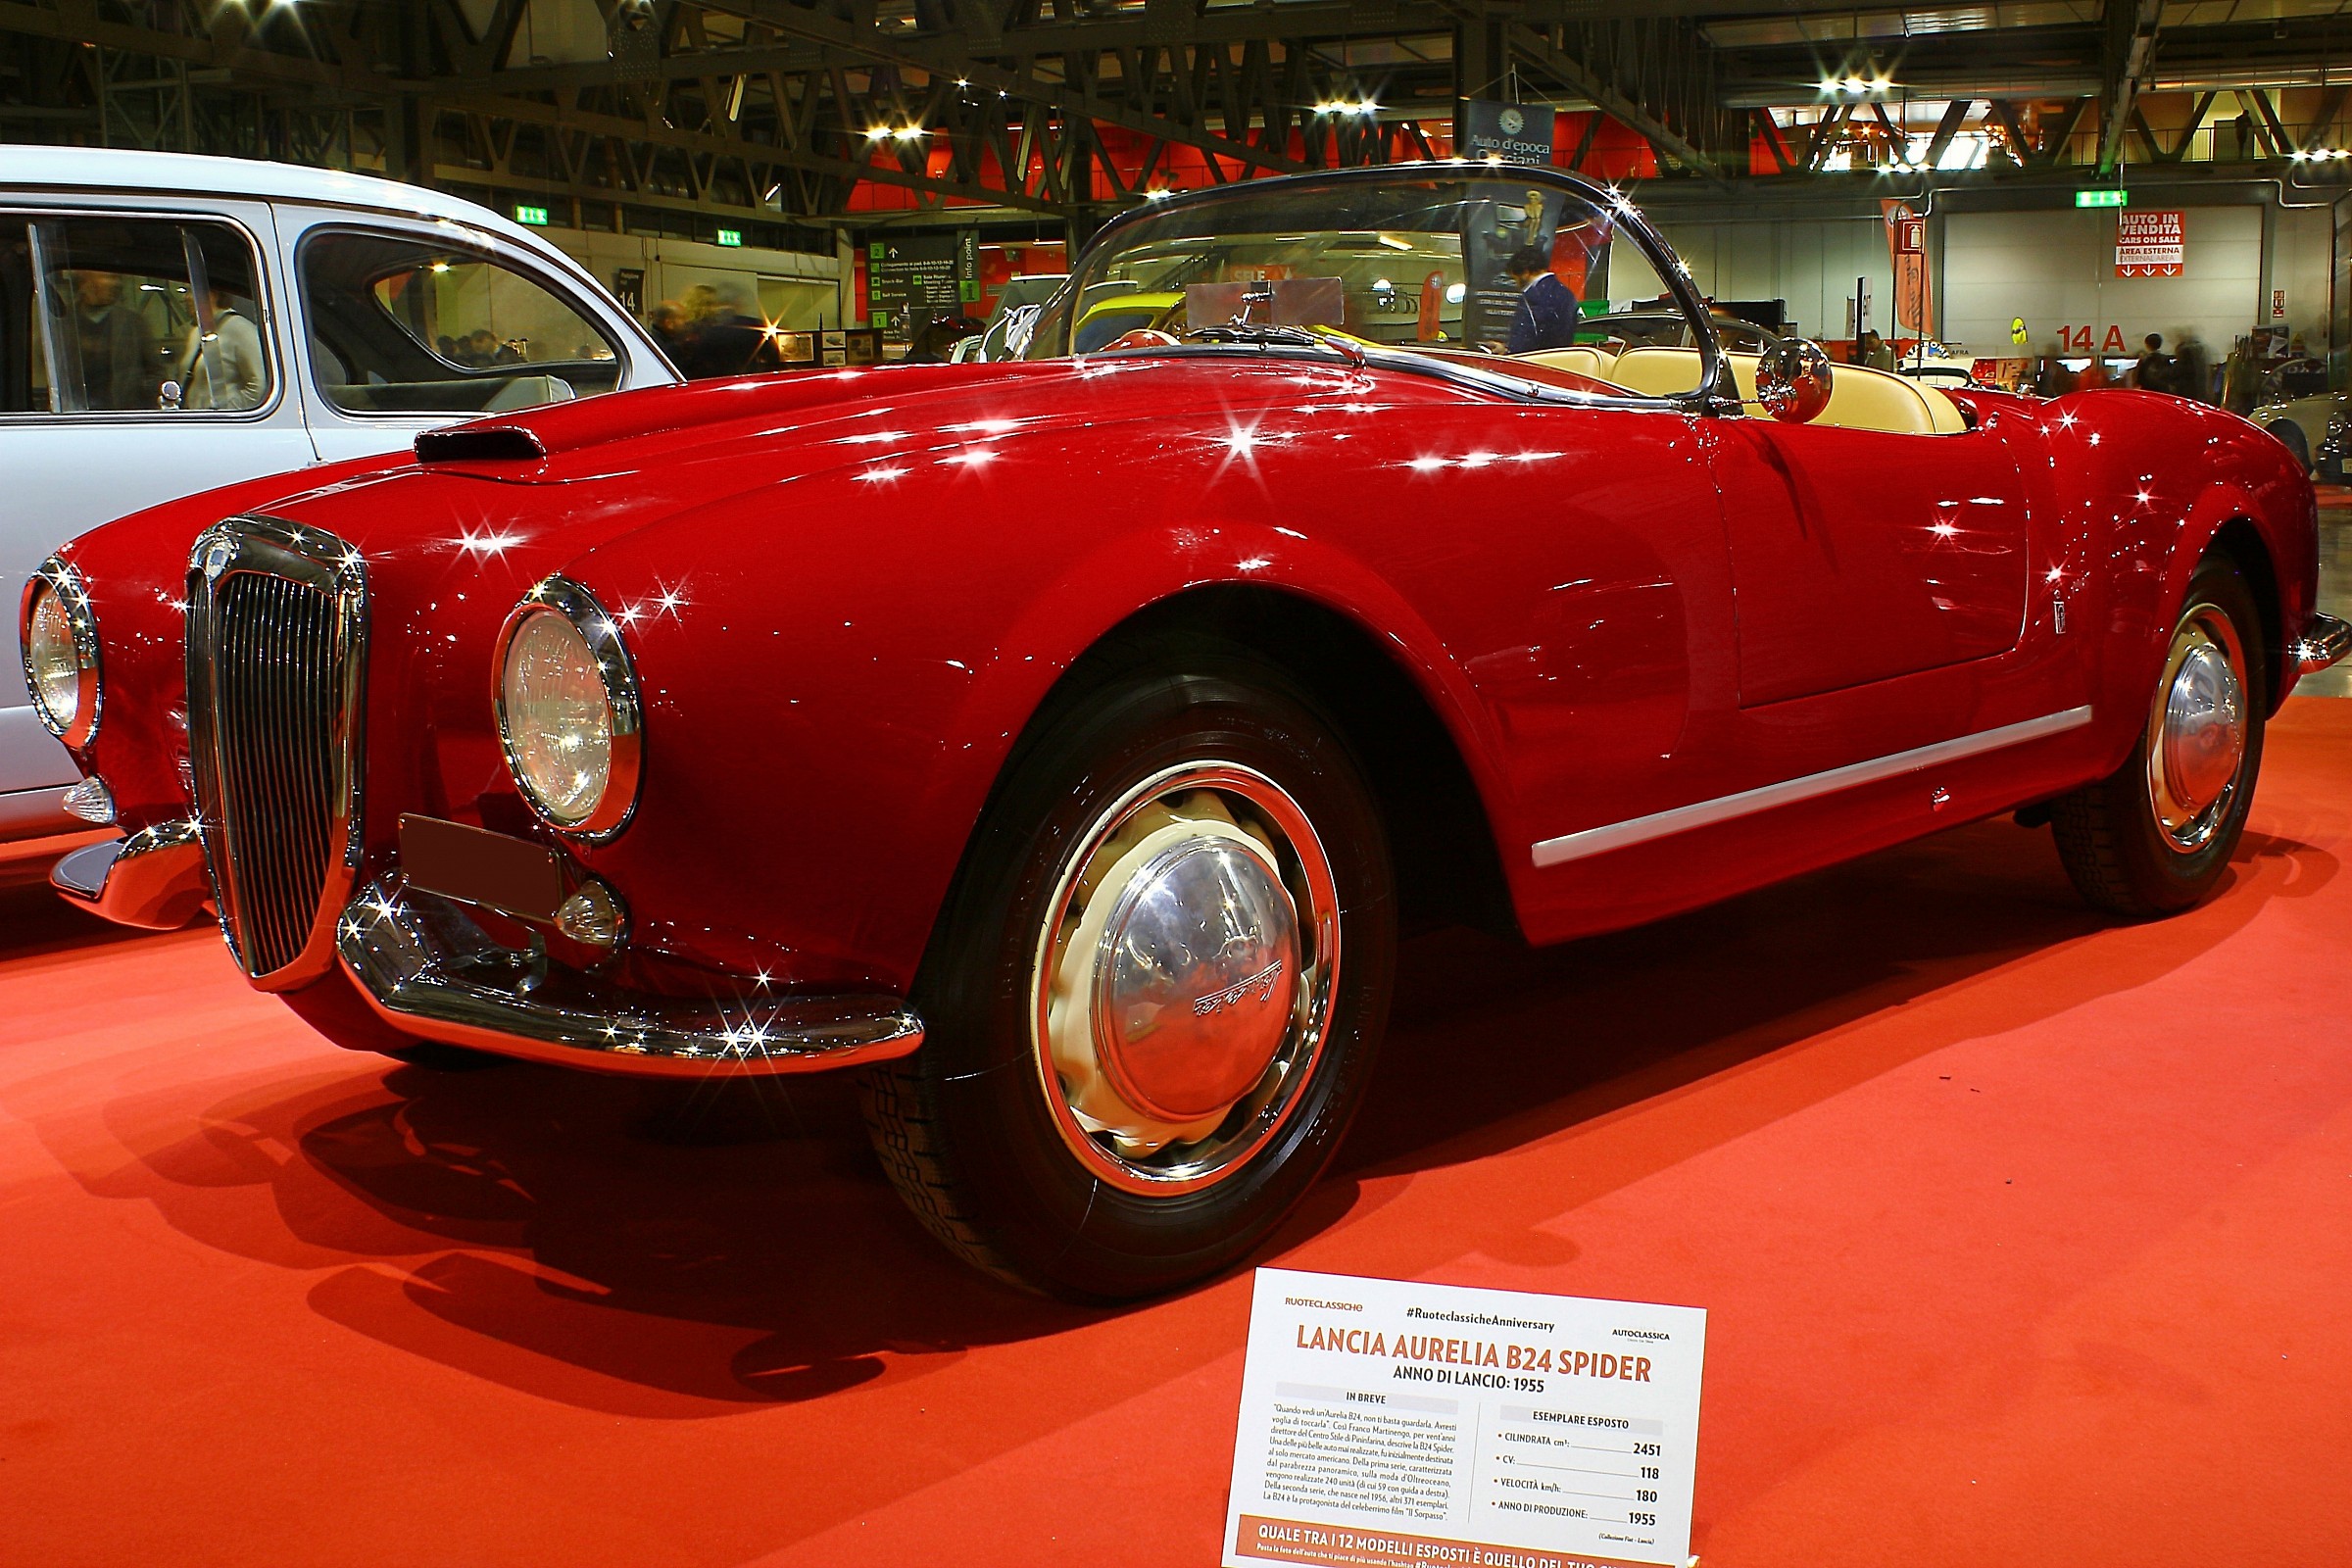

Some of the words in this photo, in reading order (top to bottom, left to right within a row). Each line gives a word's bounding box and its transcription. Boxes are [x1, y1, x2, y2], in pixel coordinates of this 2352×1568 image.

[1470, 135, 1500, 148] Auto
[1502, 138, 1550, 154] d'epoca
[2122, 214, 2158, 224] AUTO
[2163, 214, 2179, 224] IN
[2121, 224, 2181, 235] VENDITA
[964, 238, 973, 260] point
[620, 291, 635, 311] 14
[2057, 325, 2094, 352] 14
[2102, 325, 2126, 352] A
[1406, 1307, 1555, 1333] #RuoteclassicheAnniversary
[1612, 1329, 1670, 1340] AUTOCLASSICA
[1296, 1324, 1386, 1357] LANCIA
[1391, 1334, 1499, 1368] AURELIA
[1506, 1344, 1552, 1373] B24
[1557, 1349, 1651, 1382] SPIDER
[1393, 1365, 1433, 1381] ANNO
[1436, 1369, 1451, 1383] DI
[1454, 1370, 1510, 1389] LANCIO:
[1513, 1377, 1544, 1393] 1955
[1346, 1391, 1356, 1401] IN
[1357, 1393, 1386, 1404] BREVE
[1302, 1407, 1315, 1416] vedi
[1383, 1415, 1400, 1425] basta
[1533, 1411, 1585, 1425] ESEMPLARE
[1587, 1416, 1629, 1429] ESPOSTO
[1271, 1415, 1291, 1425] voglia
[1292, 1417, 1299, 1425] di
[1348, 1422, 1371, 1433] Franco
[1372, 1425, 1411, 1439] Martinengo,
[1270, 1425, 1297, 1436] direttore
[1297, 1428, 1308, 1437] del
[1308, 1429, 1329, 1440] Centro
[1329, 1431, 1344, 1441] Stile
[1344, 1433, 1350, 1442] di
[1351, 1434, 1386, 1447] Pininfarina,
[1386, 1438, 1412, 1449] descrive
[1412, 1440, 1419, 1450] la
[1419, 1441, 1432, 1451] B24
[1432, 1442, 1454, 1454] Spider.
[1504, 1432, 1551, 1445] CILINDRATA
[1269, 1436, 1282, 1445] Una
[1282, 1437, 1297, 1447] delle
[1307, 1440, 1323, 1450] belle
[1349, 1446, 1380, 1457] realizzate,
[1380, 1448, 1387, 1457] fu
[1387, 1450, 1424, 1461] inizialmente
[1425, 1453, 1453, 1465] destinata
[1633, 1442, 1661, 1456] 2451
[1268, 1447, 1274, 1455] al
[1275, 1448, 1288, 1457] solo
[1289, 1452, 1316, 1460] mercato
[1352, 1456, 1369, 1466] Della
[1370, 1460, 1389, 1469] prima
[1390, 1462, 1407, 1471] serie,
[1408, 1465, 1452, 1476] caratterizzata
[1502, 1455, 1515, 1464] CV:
[1266, 1458, 1278, 1467] dal
[1279, 1461, 1316, 1471] parabrezza
[1317, 1466, 1359, 1477] panoramico,
[1361, 1469, 1377, 1478] sulla
[1379, 1472, 1398, 1481] moda
[1400, 1473, 1451, 1488] d'Oltreoceano,
[1640, 1466, 1659, 1479] 118
[1264, 1479, 1281, 1490] Della
[1282, 1484, 1308, 1493] seconda
[1309, 1487, 1326, 1496] serie,
[1327, 1487, 1339, 1497] che
[1359, 1491, 1370, 1500] nel
[1371, 1493, 1388, 1503] 1956,
[1389, 1494, 1402, 1504] altri
[1403, 1496, 1415, 1505] 371
[1265, 1471, 1293, 1480] vengono
[1294, 1473, 1324, 1484] realizzate
[1325, 1476, 1338, 1485] 240
[1338, 1479, 1355, 1487] unità
[1356, 1479, 1366, 1490] (di
[1377, 1482, 1386, 1491] 59
[1400, 1485, 1418, 1495] guida
[1500, 1477, 1538, 1490] VELOCITÀ
[1541, 1482, 1561, 1493] km/h:
[1263, 1490, 1271, 1500] La
[1272, 1491, 1285, 1501] B24
[1292, 1494, 1298, 1503] la
[1299, 1498, 1339, 1508] protagonista
[1340, 1500, 1351, 1509] del
[1351, 1502, 1390, 1514] celeberrimo
[1391, 1505, 1404, 1516] film
[1636, 1489, 1657, 1503] 180
[1498, 1500, 1522, 1511] ANNO
[1523, 1503, 1532, 1512] DI
[1533, 1504, 1588, 1519] PRODUZIONE:
[1628, 1511, 1656, 1526] 1955
[1256, 1542, 1272, 1551] Posta
[1279, 1545, 1292, 1553] foto
[1258, 1524, 1301, 1542] QUALE
[1303, 1529, 1327, 1545] TRA
[1331, 1533, 1335, 1546] I
[1338, 1533, 1353, 1548] 12
[1356, 1536, 1413, 1556] MODELLI
[1416, 1543, 1469, 1562] ESPOSTI
[1473, 1546, 1481, 1564] È
[1484, 1551, 1535, 1568] QUELLO
